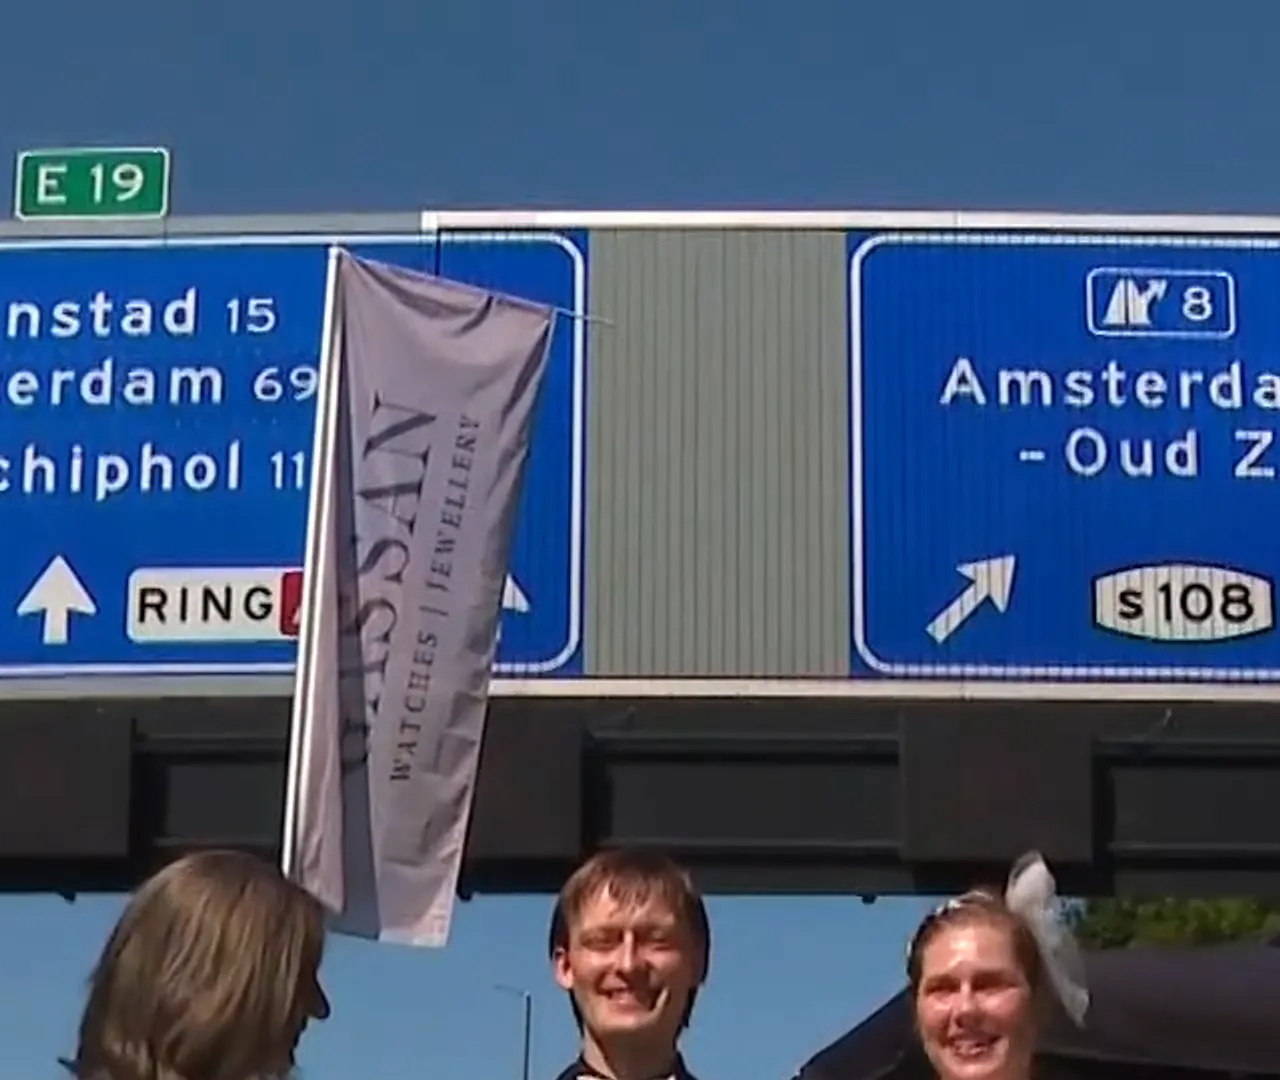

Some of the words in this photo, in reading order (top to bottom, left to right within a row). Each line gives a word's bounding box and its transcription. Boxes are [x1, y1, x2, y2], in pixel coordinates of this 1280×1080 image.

[35, 165, 66, 204] E
[89, 161, 144, 202] 19
[225, 298, 277, 334] 15
[1181, 286, 1213, 322] 8
[252, 366, 318, 402] 69
[271, 452, 305, 490] 11
[137, 586, 273, 623] RING
[390, 630, 438, 783] WATCHES
[424, 412, 481, 594] JEWELLERY
